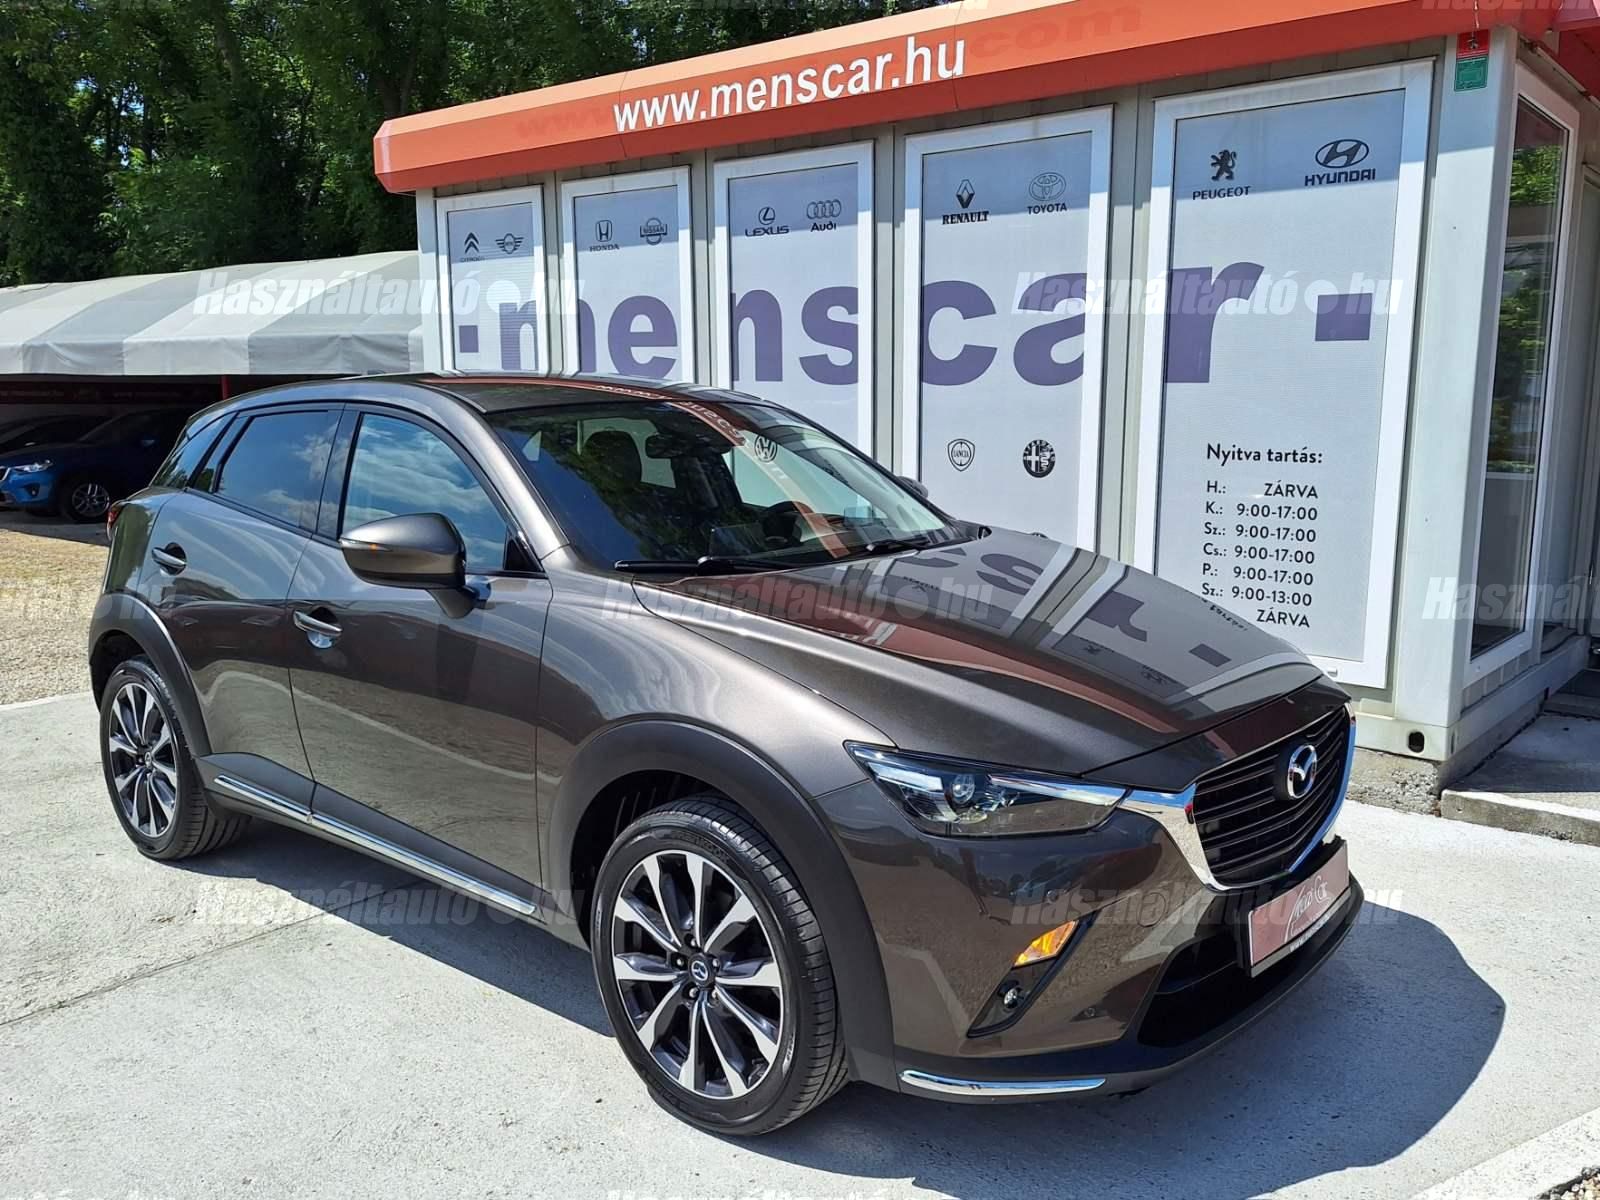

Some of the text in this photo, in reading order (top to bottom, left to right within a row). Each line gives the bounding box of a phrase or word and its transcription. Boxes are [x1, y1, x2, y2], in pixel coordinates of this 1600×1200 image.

[613, 36, 965, 132] www.menscar.hu
[1304, 168, 1376, 186] HYUNDAI
[1192, 185, 1252, 201] PEUGEOT
[942, 210, 990, 225] RENAULT
[1027, 202, 1068, 215] TOYOTA
[745, 225, 790, 237] LEXUS
[810, 221, 837, 232] Audi
[589, 243, 620, 252] HONDA
[1206, 443, 1323, 467] Nyitva tartás:
[1206, 480, 1319, 499] H.: ZÁRVA
[1205, 501, 1318, 521] K.: 9:00-17:00
[1204, 522, 1316, 543] Sz.: 9:00-17:00
[1203, 542, 1315, 564] Cs.: 9:00-17:00
[1202, 562, 1314, 586] P.: 9:00-17:00
[1201, 582, 1312, 607] Sz.: 9:00-13:00
[1256, 606, 1310, 628] ZÁRVA
